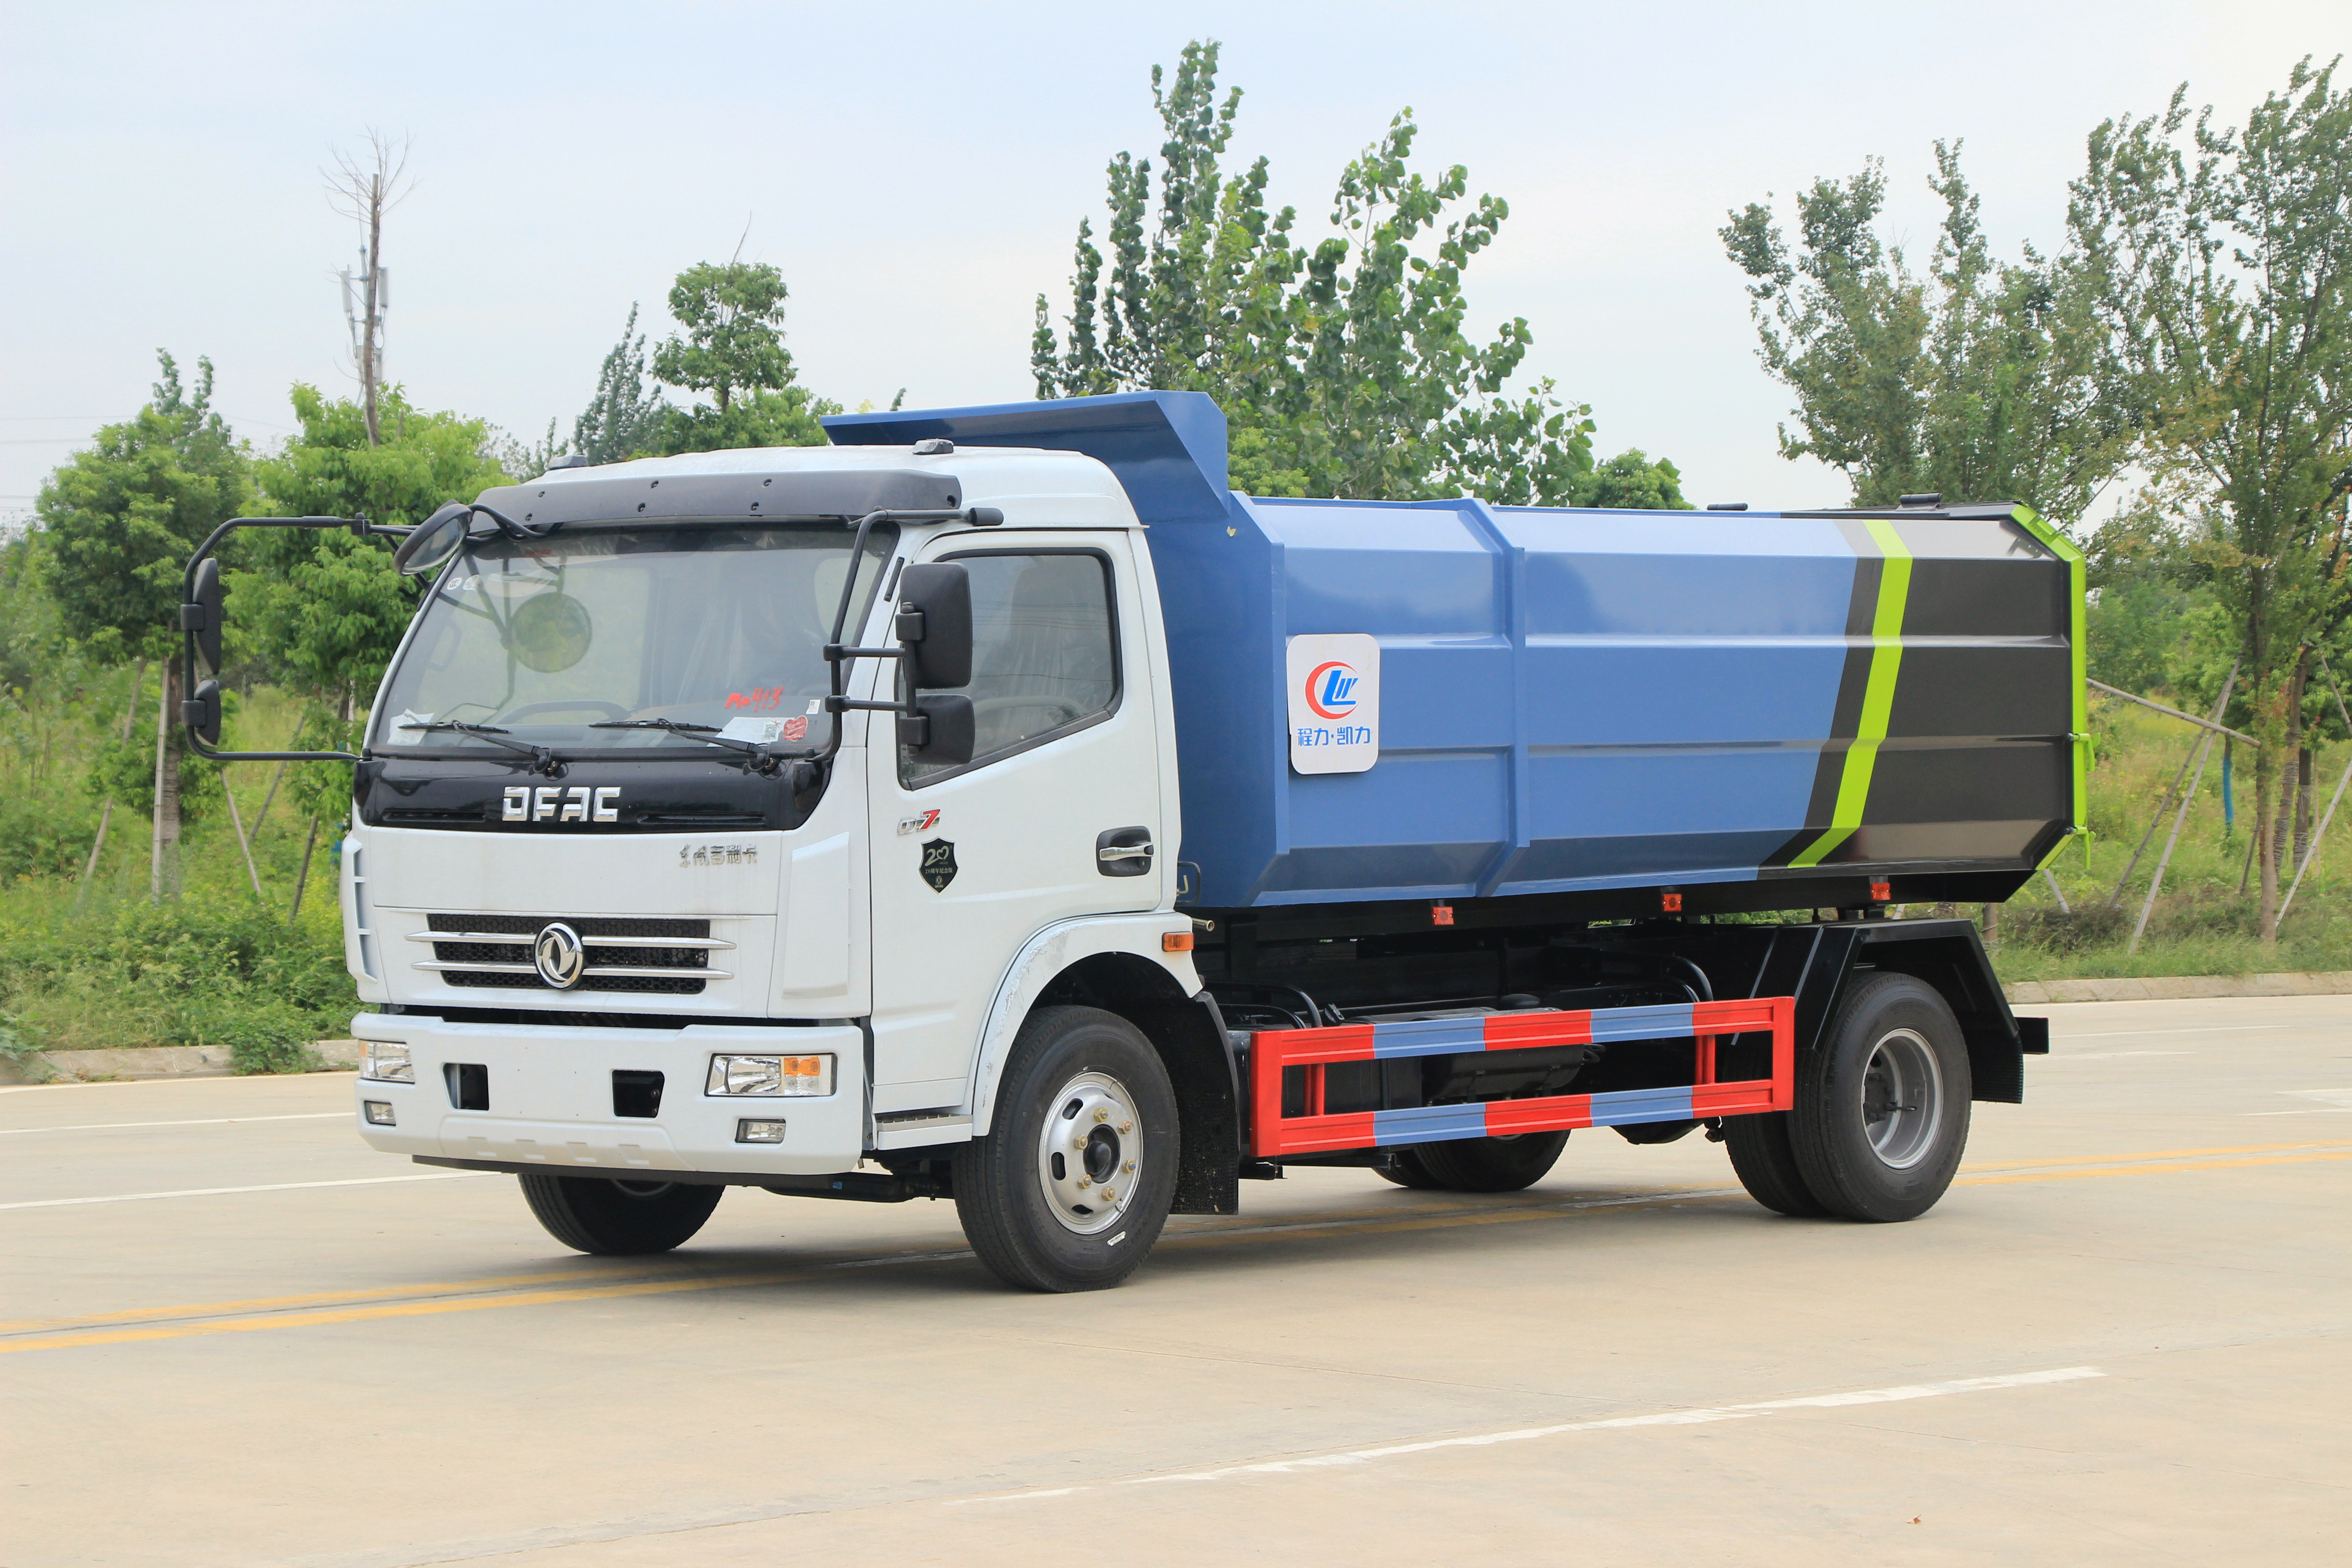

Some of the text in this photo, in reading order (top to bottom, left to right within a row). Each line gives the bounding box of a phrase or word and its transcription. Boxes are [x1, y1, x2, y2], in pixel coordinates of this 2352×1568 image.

[1297, 726, 1371, 746] 程力·凯力
[502, 786, 620, 822] DFAC
